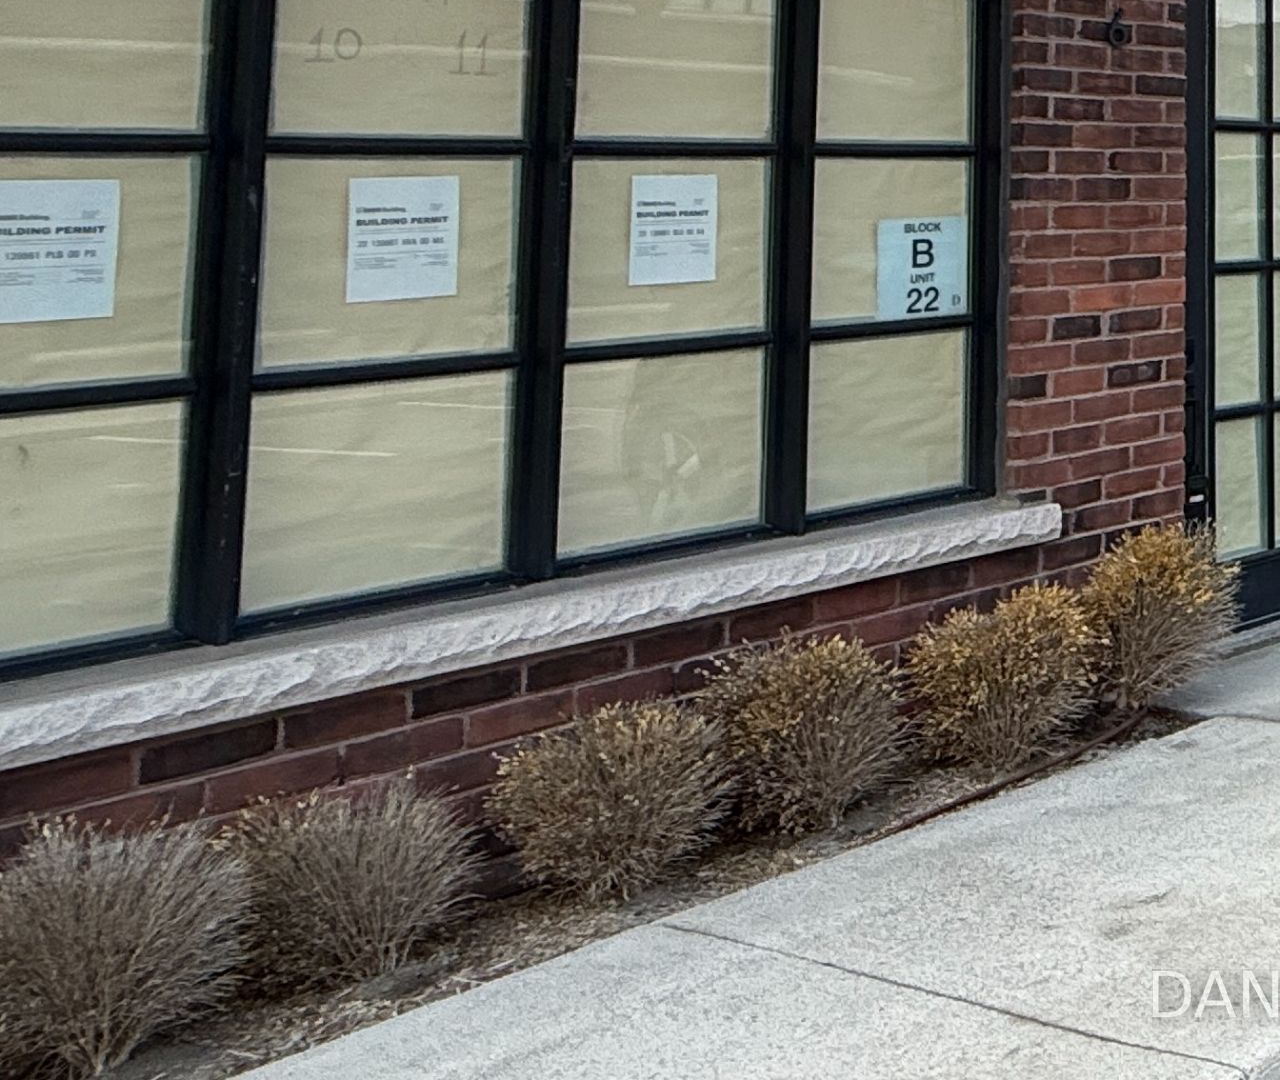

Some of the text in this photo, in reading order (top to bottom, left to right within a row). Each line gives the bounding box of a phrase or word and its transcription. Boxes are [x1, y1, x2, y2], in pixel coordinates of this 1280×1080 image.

[305, 26, 497, 76] 10 11
[55, 225, 106, 235] PERMIT
[904, 223, 941, 234] BLOCK
[912, 239, 935, 268] B
[910, 272, 935, 284] UNIT
[906, 286, 940, 314] 22
